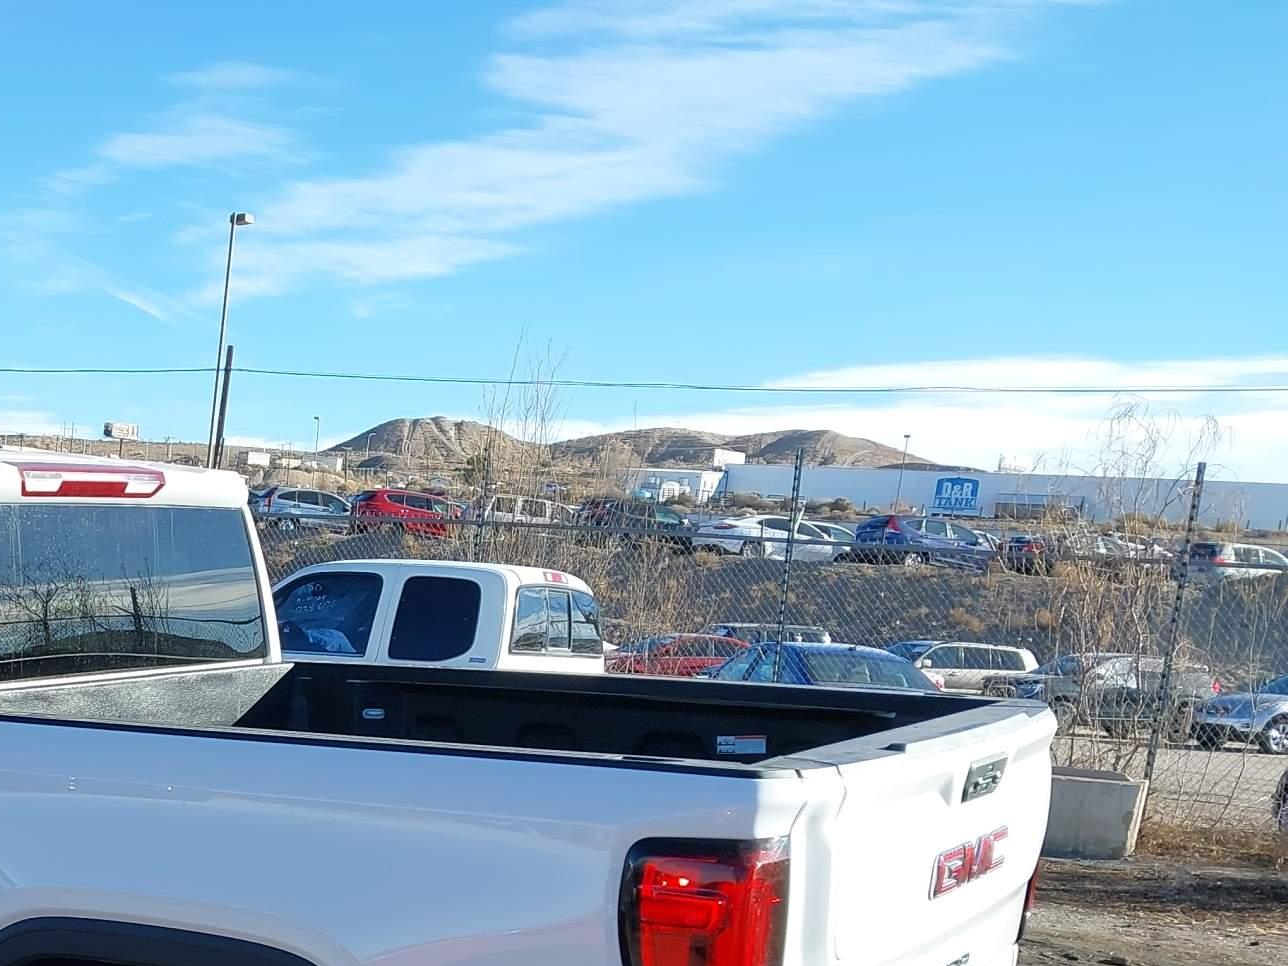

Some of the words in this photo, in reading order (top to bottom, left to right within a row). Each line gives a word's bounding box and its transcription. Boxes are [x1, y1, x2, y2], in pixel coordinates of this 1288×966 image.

[942, 481, 973, 497] D&R
[935, 496, 976, 507] TANK
[928, 825, 1009, 900] GMC
